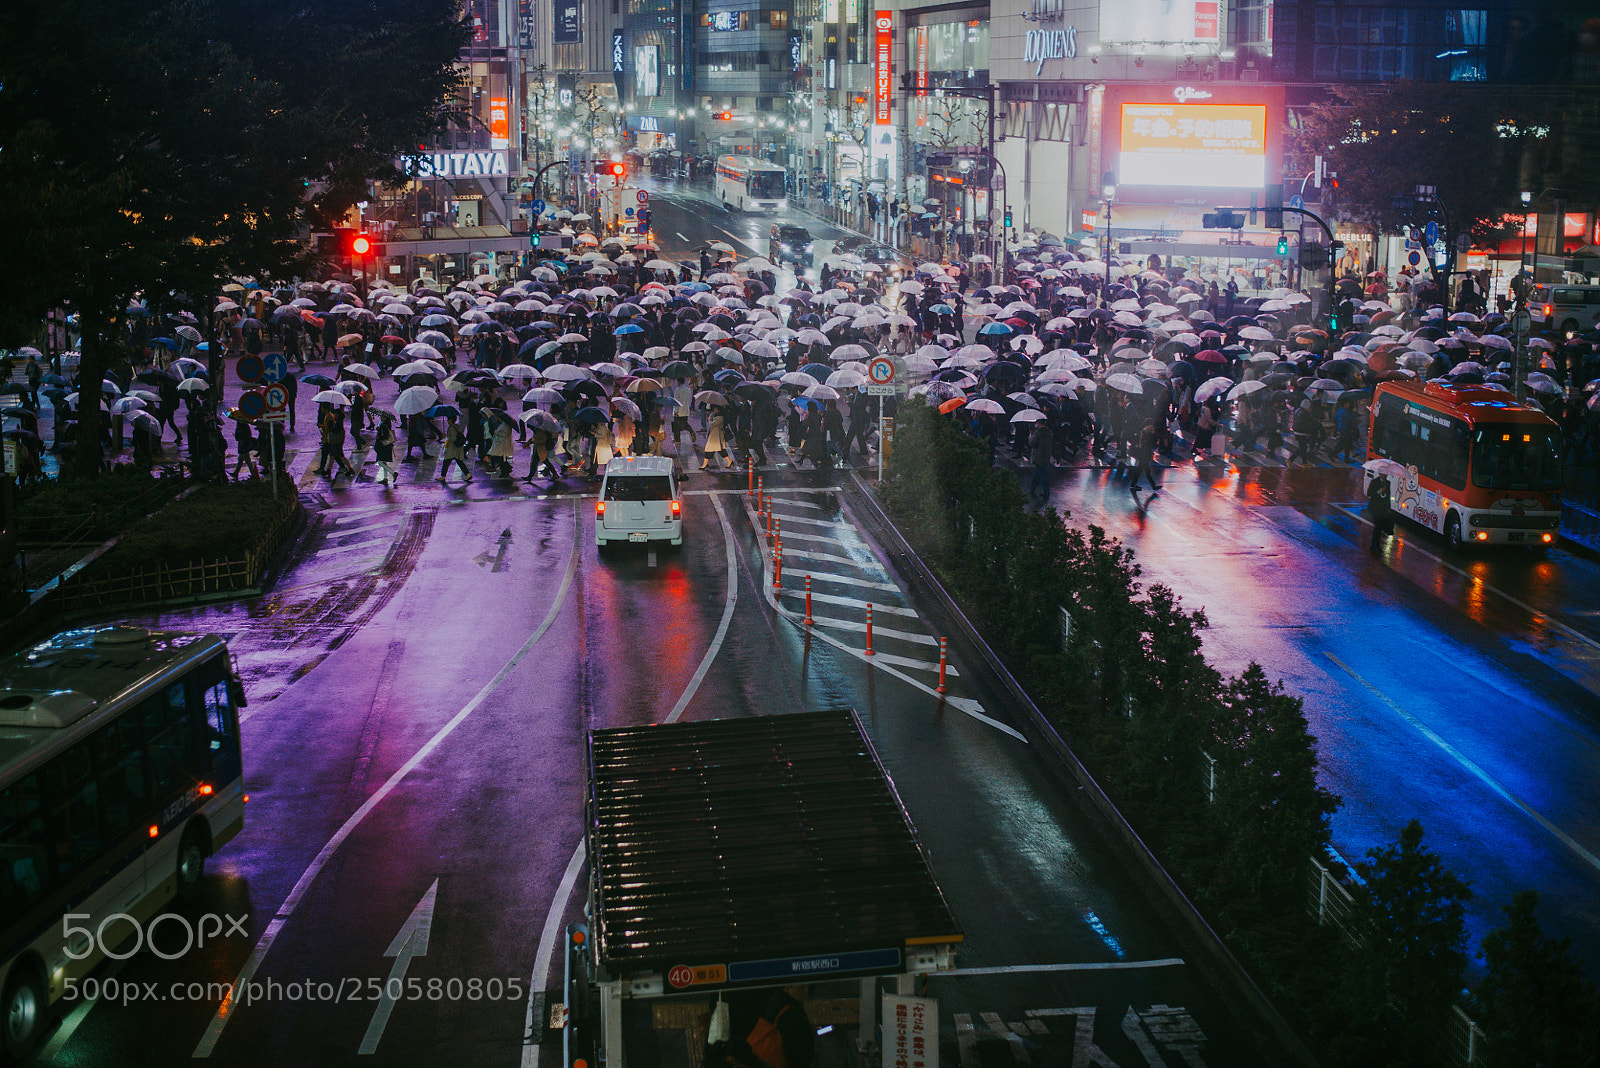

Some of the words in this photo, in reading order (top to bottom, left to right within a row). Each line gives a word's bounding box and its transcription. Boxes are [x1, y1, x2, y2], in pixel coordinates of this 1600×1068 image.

[613, 35, 623, 72] ZARA
[640, 116, 659, 131] ZARA
[400, 152, 508, 177] TSUTAYA
[869, 386, 893, 395] ここから
[791, 957, 840, 972] 新宿駅西口
[670, 970, 692, 984] 40
